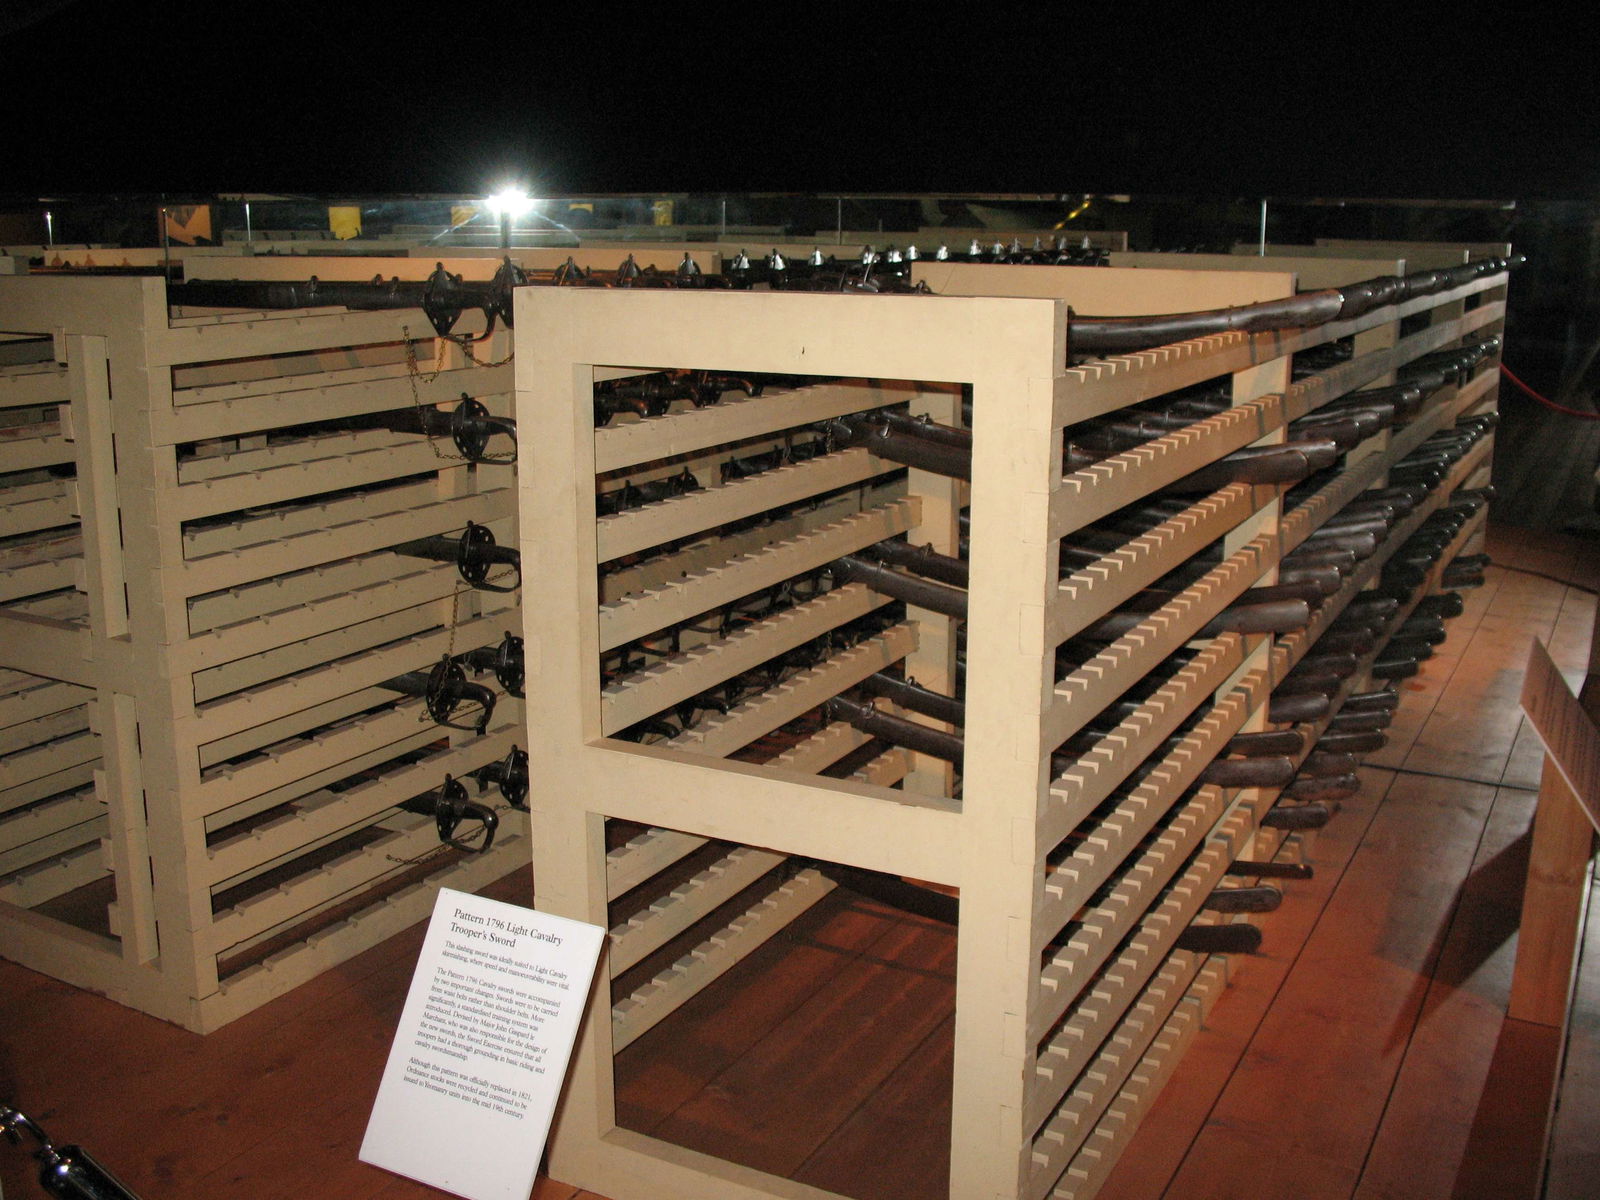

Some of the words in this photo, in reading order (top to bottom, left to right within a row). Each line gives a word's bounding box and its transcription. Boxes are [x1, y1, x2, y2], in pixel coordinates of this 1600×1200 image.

[451, 922, 487, 940] Trooper's
[489, 933, 516, 948] Sword
[454, 908, 484, 924] Pattern
[486, 917, 505, 930] 1796
[506, 922, 528, 936] Light
[530, 929, 563, 946] Cavalry
[445, 940, 455, 949] This
[474, 950, 489, 958] sword
[535, 965, 548, 975] Light
[549, 969, 567, 981] Cavalry
[470, 958, 483, 966] where
[431, 985, 443, 994] from
[456, 992, 467, 1001] belts
[468, 997, 483, 1005] rather
[483, 1000, 494, 1009] than
[495, 1004, 517, 1015] shoulder
[530, 1014, 544, 1023] More
[437, 967, 447, 975] The
[447, 970, 465, 980] Pattern
[478, 979, 497, 990] Cavalry
[498, 986, 515, 995] swords
[527, 995, 561, 1008] accompanied
[450, 982, 474, 993] important
[496, 994, 514, 1004] Swords
[515, 1000, 527, 1008] were
[540, 1008, 559, 1017] carried
[452, 1011, 473, 1022] Devised
[495, 1023, 507, 1033] John
[461, 1005, 492, 1018] standardised
[491, 1013, 511, 1025] training
[414, 1040, 431, 1050] cavalry
[417, 1030, 437, 1041] troopers
[437, 1036, 447, 1044] had
[451, 1040, 473, 1052] thorough
[473, 1048, 500, 1061] grounding
[506, 1057, 518, 1066] basic
[519, 1062, 535, 1072] riding
[439, 1028, 457, 1038] swords,
[457, 1032, 466, 1040] the
[466, 1034, 483, 1045] Sword
[503, 1047, 524, 1058] ensured
[524, 1053, 534, 1061] that
[469, 1026, 479, 1034] also
[479, 1030, 506, 1042] responsible
[524, 1042, 540, 1053] design
[406, 1066, 430, 1078] Ordnance
[430, 1075, 445, 1083] stocks
[445, 1079, 457, 1088] were
[457, 1083, 479, 1094] recycled
[478, 1090, 489, 1098] and
[488, 1093, 514, 1106] continued
[408, 1057, 431, 1069] Although
[431, 1064, 440, 1072] this
[440, 1068, 458, 1078] pattern
[469, 1076, 489, 1089] officially
[490, 1083, 512, 1094] replaced
[403, 1075, 419, 1085] issued
[424, 1081, 448, 1095] Yeomanry
[461, 1094, 472, 1102] into
[480, 1101, 492, 1109] mid
[492, 1103, 504, 1113] 19th
